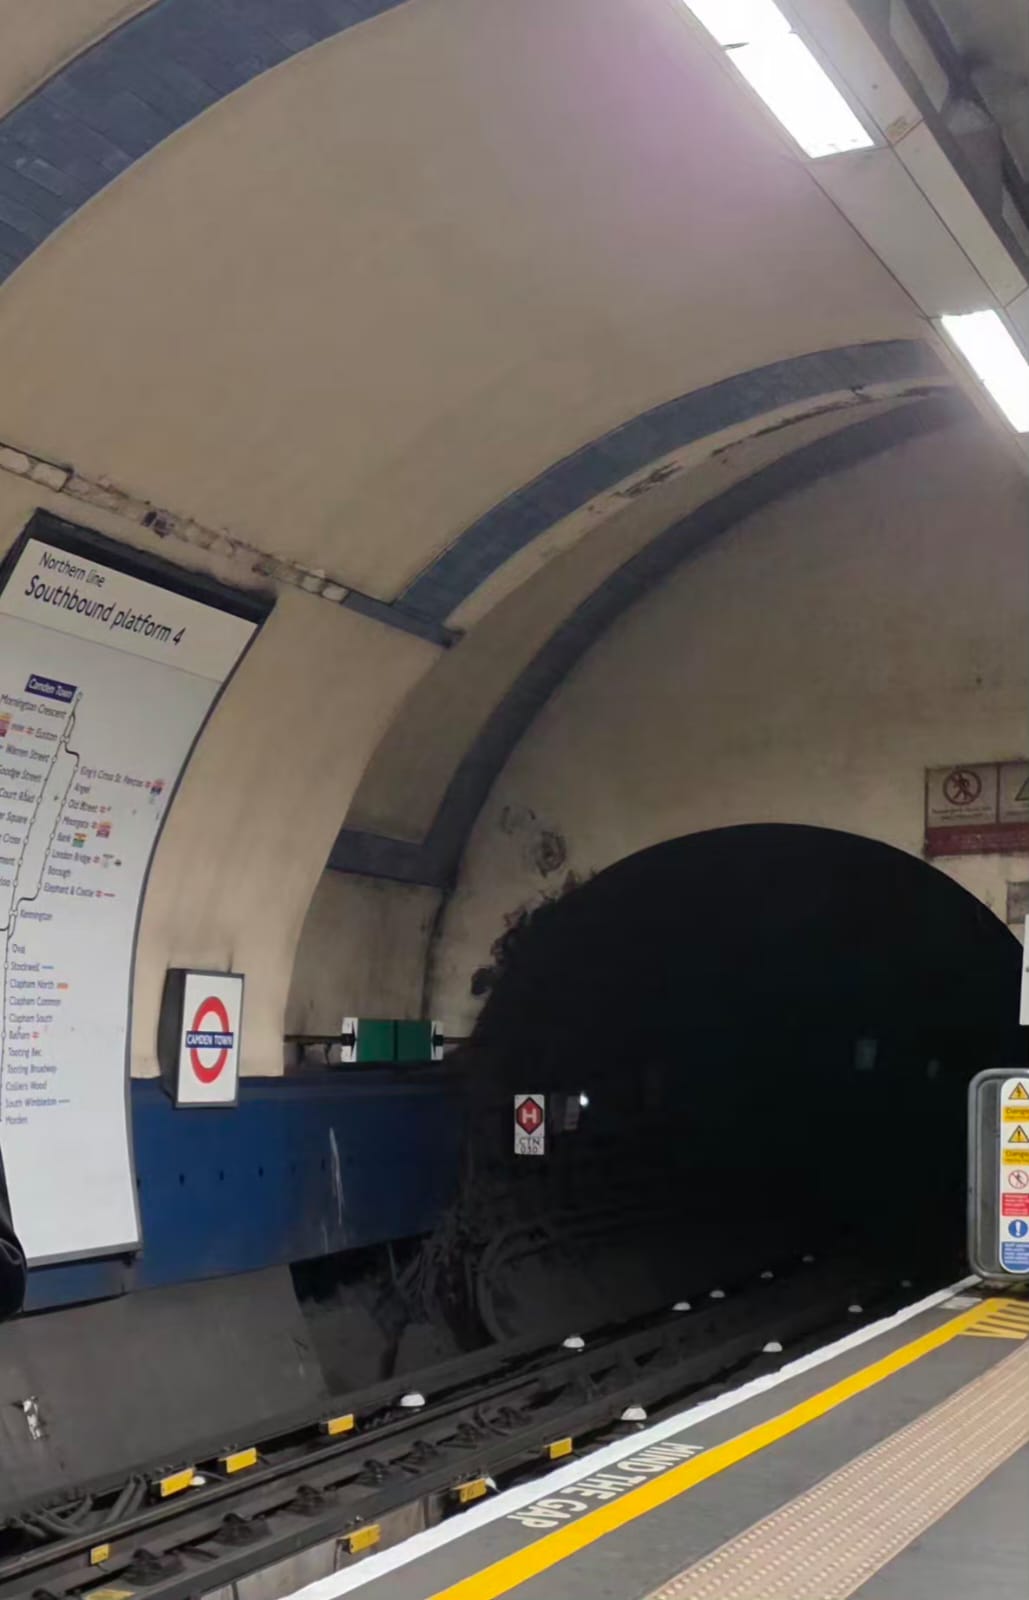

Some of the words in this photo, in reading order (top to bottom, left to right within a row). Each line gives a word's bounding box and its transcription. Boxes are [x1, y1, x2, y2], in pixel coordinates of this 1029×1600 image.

[40, 552, 86, 581] Northern
[86, 568, 105, 588] line
[25, 575, 117, 622] Southbound
[110, 608, 172, 643] platform
[172, 627, 186, 646] 4
[29, 678, 56, 694] Camden
[56, 685, 73, 698] Town
[38, 704, 67, 719] Crescent
[187, 1033, 212, 1046] CAMDEN
[214, 1034, 233, 1046] TOWN
[522, 1108, 537, 1124] H
[617, 1441, 705, 1472] MIND
[560, 1473, 647, 1499] THE
[506, 1499, 588, 1528] GAP
